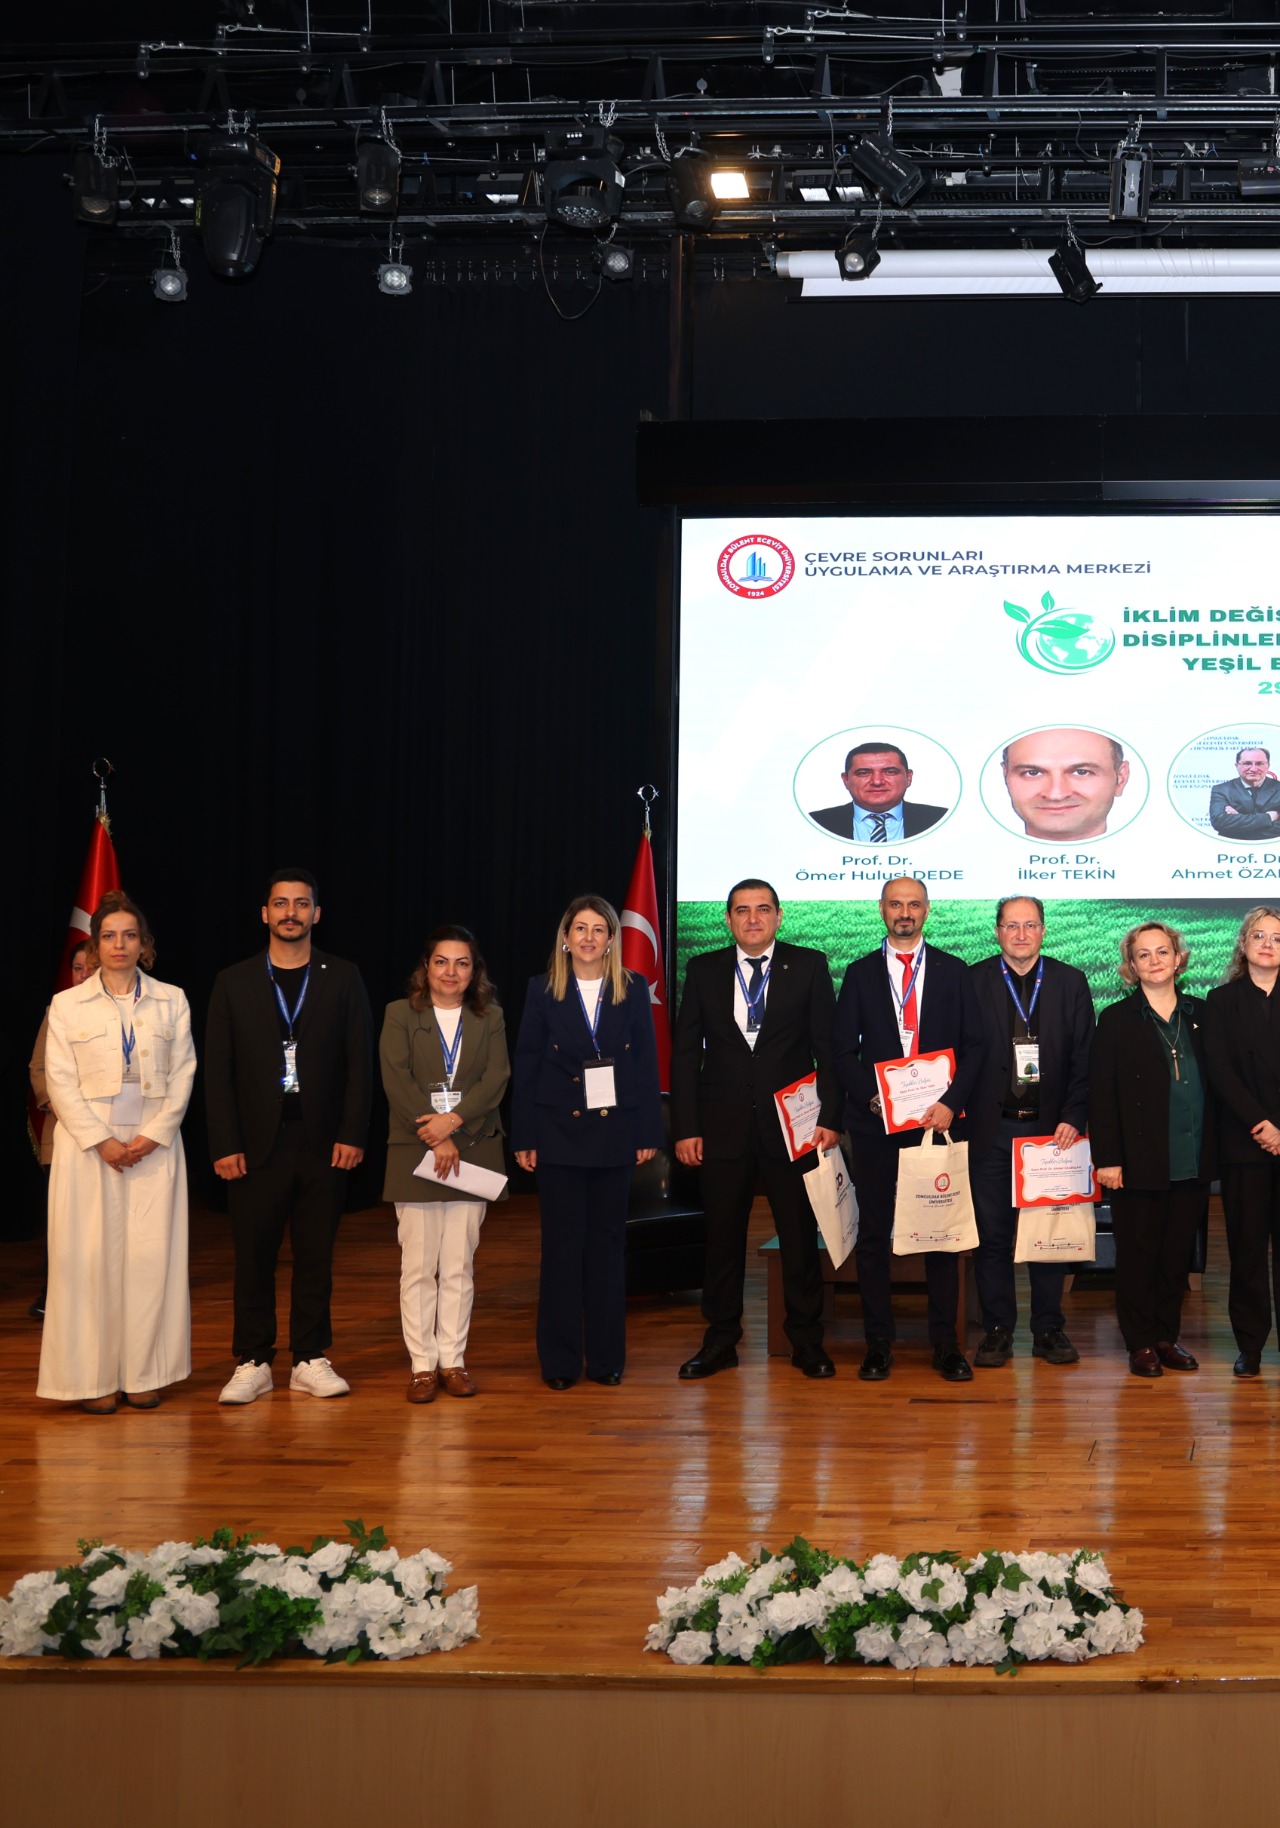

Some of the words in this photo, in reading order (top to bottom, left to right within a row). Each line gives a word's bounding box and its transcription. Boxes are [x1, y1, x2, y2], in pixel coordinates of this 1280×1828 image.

[727, 536, 755, 554] BÜLENT
[757, 536, 783, 551] ECEVİT
[804, 551, 867, 565] ÇEVRE
[872, 550, 983, 562] SORUNLARI
[720, 553, 740, 592] ZONGULDAK
[772, 549, 792, 593] ÜNİVERSİTESİ
[804, 566, 912, 577] UYGULAMA
[919, 565, 942, 576] VE
[948, 564, 1061, 577] ARAŞTIRMA
[1066, 560, 1151, 574] MERKEZİ
[1123, 606, 1200, 623] İKLİM
[1182, 654, 1261, 674] YEŞİL
[842, 855, 883, 866] Prof.
[888, 855, 913, 866] Dr.
[1029, 854, 1070, 865] Prof.
[1076, 854, 1101, 865] Dr.
[1217, 853, 1258, 864] Prof.
[795, 868, 846, 881] Ömer
[852, 869, 907, 881] Hulusi
[913, 870, 964, 881] DEDE
[1018, 867, 1057, 880] İlker
[1062, 867, 1116, 880] TEKİN
[1171, 867, 1233, 879] Ahmet
